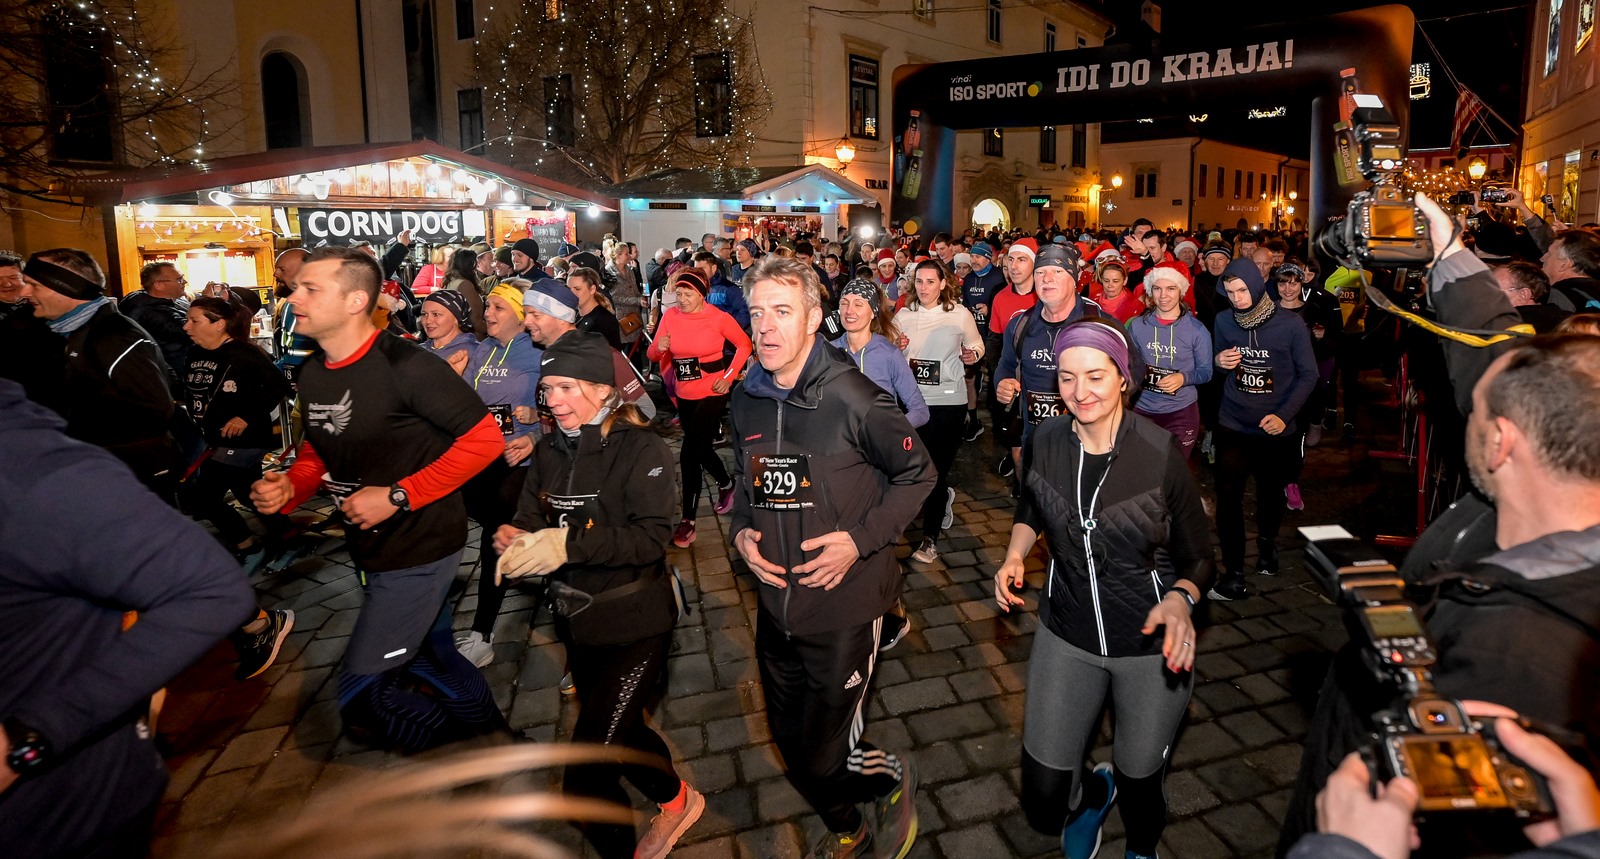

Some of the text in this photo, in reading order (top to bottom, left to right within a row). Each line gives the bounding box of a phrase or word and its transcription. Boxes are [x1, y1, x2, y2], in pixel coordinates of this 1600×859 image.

[1056, 39, 1294, 92] IDI DO KRAJA!
[950, 82, 1026, 101] ISO SPORT
[1340, 144, 1352, 167] SPORT
[864, 178, 888, 190] URAR
[308, 211, 459, 237] CORN DOG
[680, 364, 691, 375] 94
[917, 366, 930, 378] 26
[1242, 374, 1264, 387] 406
[1034, 402, 1060, 418] 326
[764, 471, 796, 495] 329
